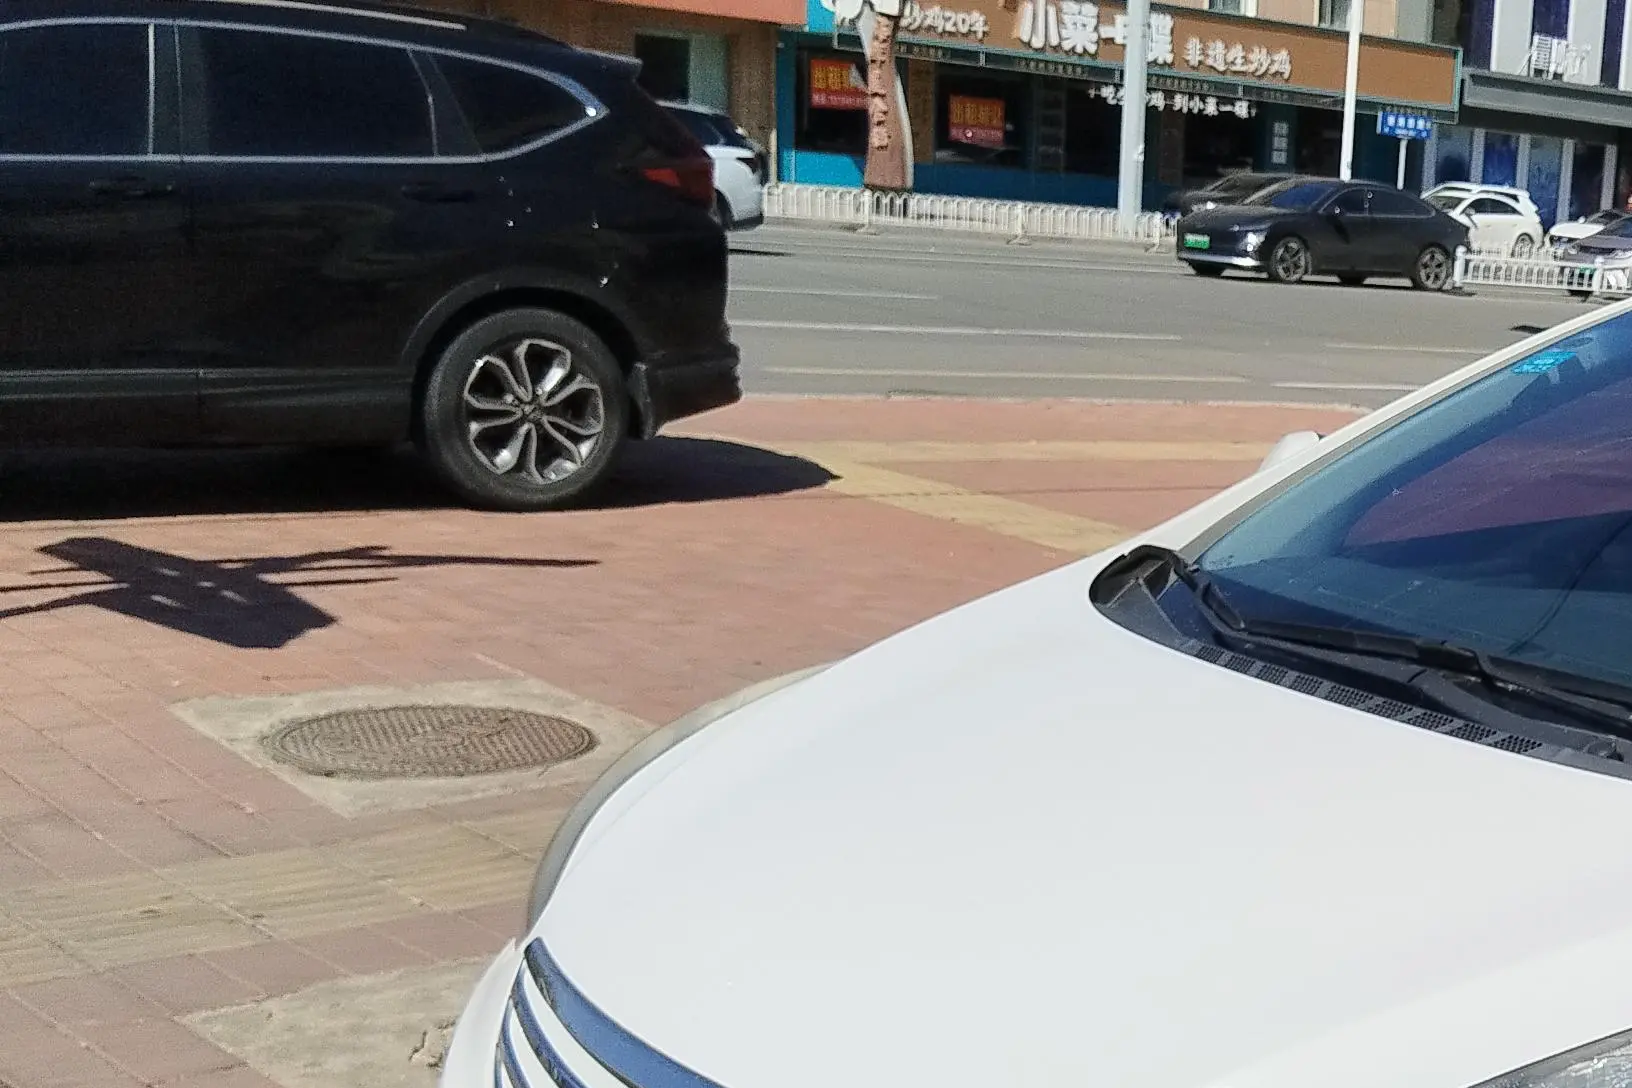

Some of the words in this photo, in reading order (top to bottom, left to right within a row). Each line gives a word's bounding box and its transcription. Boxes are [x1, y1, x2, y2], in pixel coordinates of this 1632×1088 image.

[1185, 36, 1292, 80] 非遗生炒鸡
